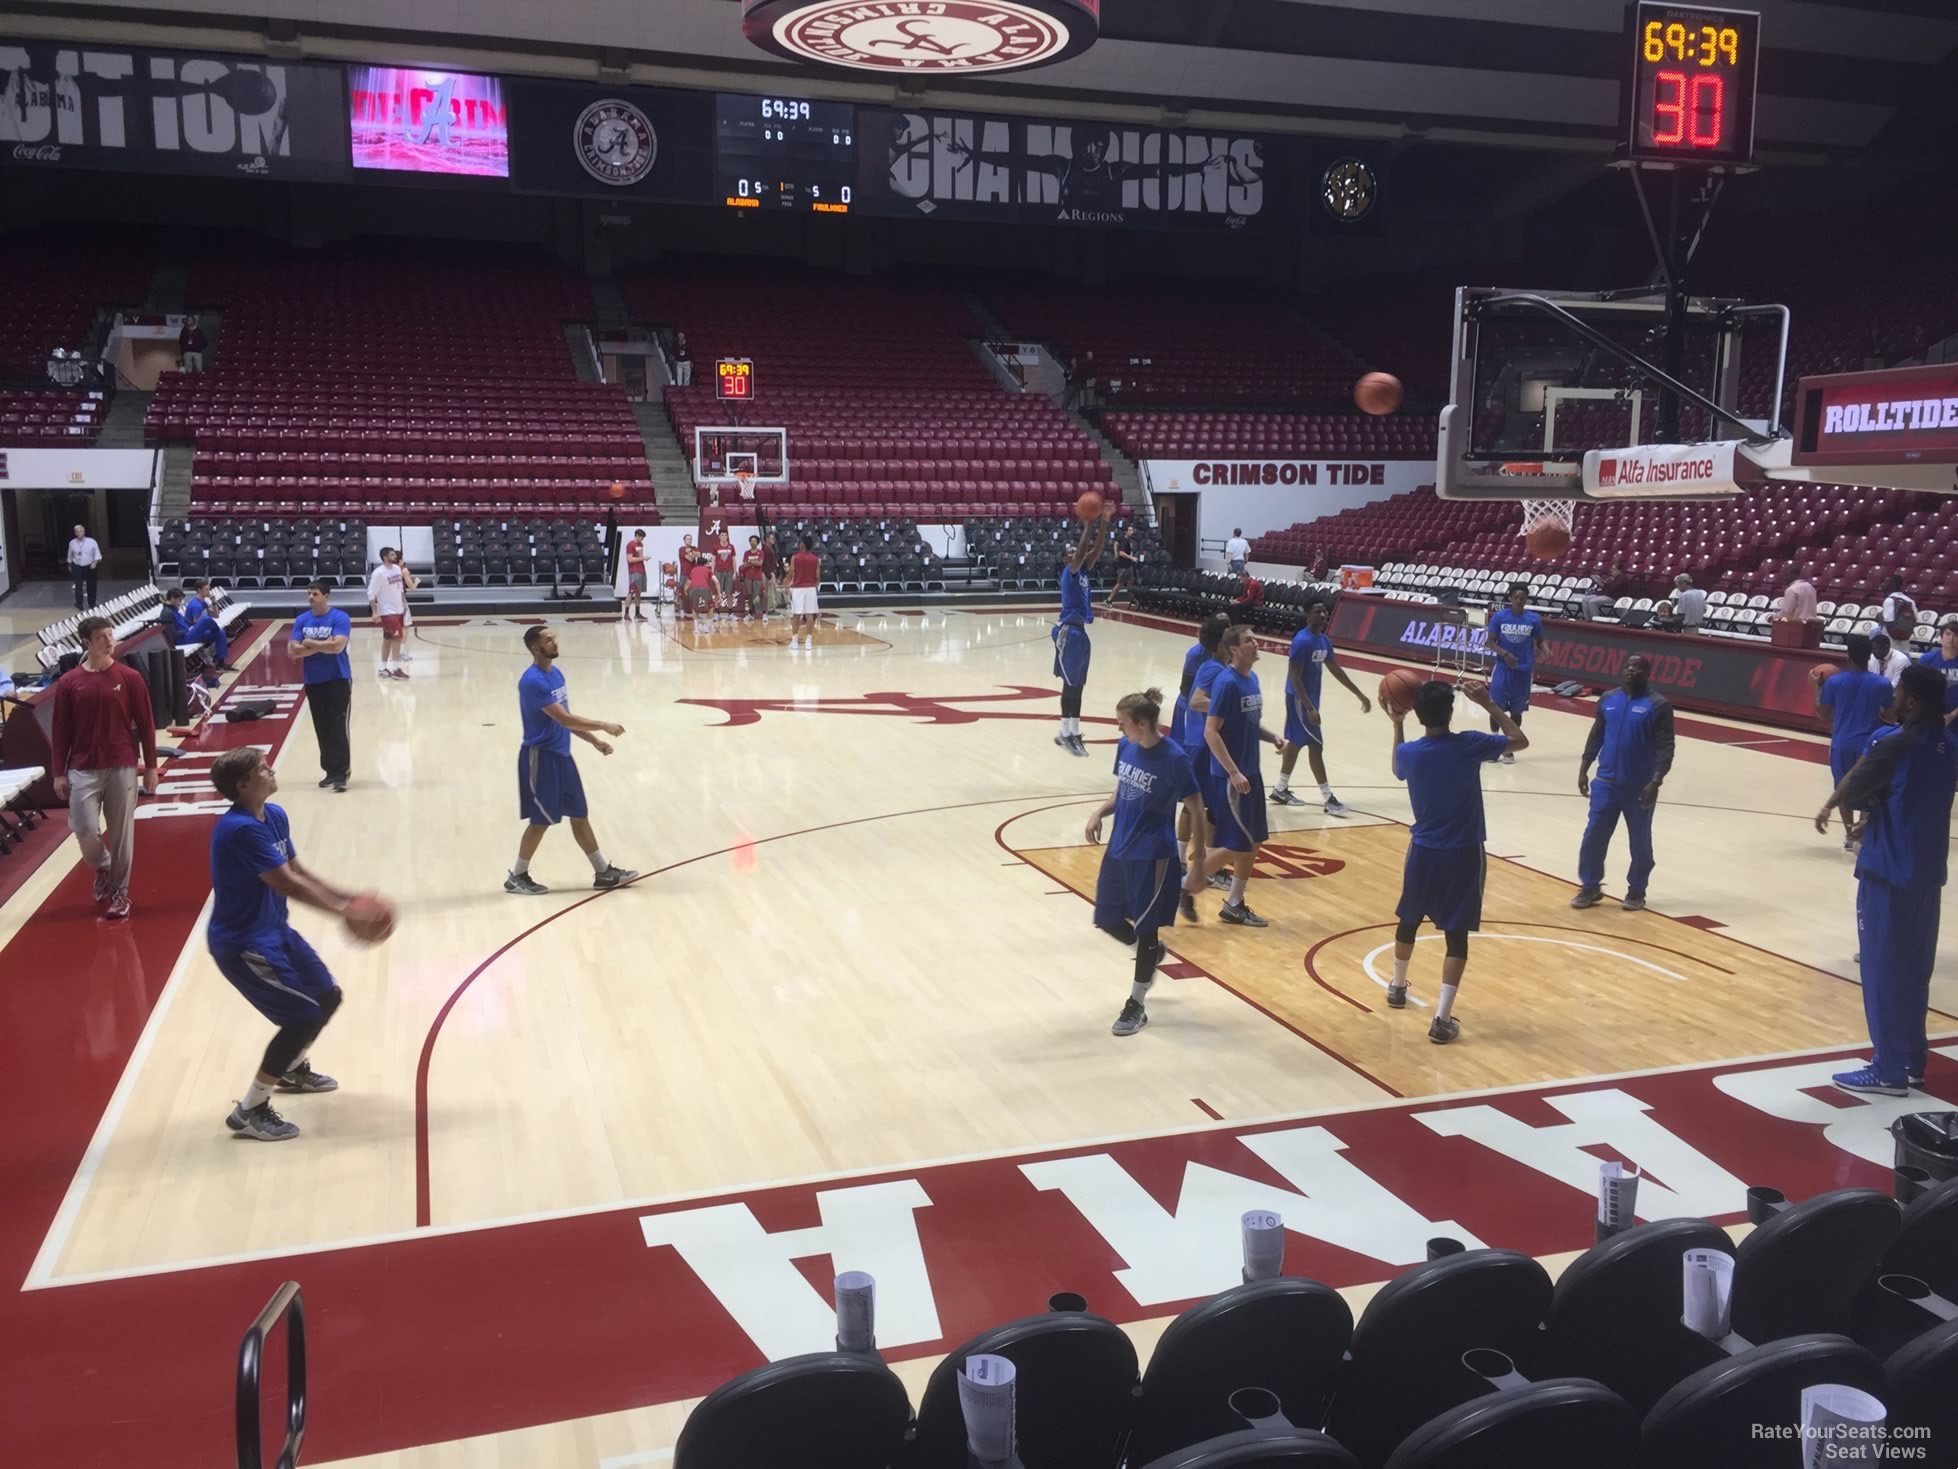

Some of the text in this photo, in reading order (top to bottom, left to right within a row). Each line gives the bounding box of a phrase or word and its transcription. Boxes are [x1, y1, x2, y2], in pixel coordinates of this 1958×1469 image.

[1644, 21, 1738, 66] 69:39
[761, 99, 811, 120] 69:39
[1655, 71, 1724, 146] 30
[739, 179, 748, 197] 0
[841, 186, 851, 203] 0
[1071, 208, 1125, 224] REGIONS
[719, 364, 750, 376] 69:39
[725, 376, 745, 395] 30
[1193, 463, 1385, 486] CRIMSON TIDE
[1618, 459, 1645, 484] Alfa
[1648, 457, 1714, 482] Insurance
